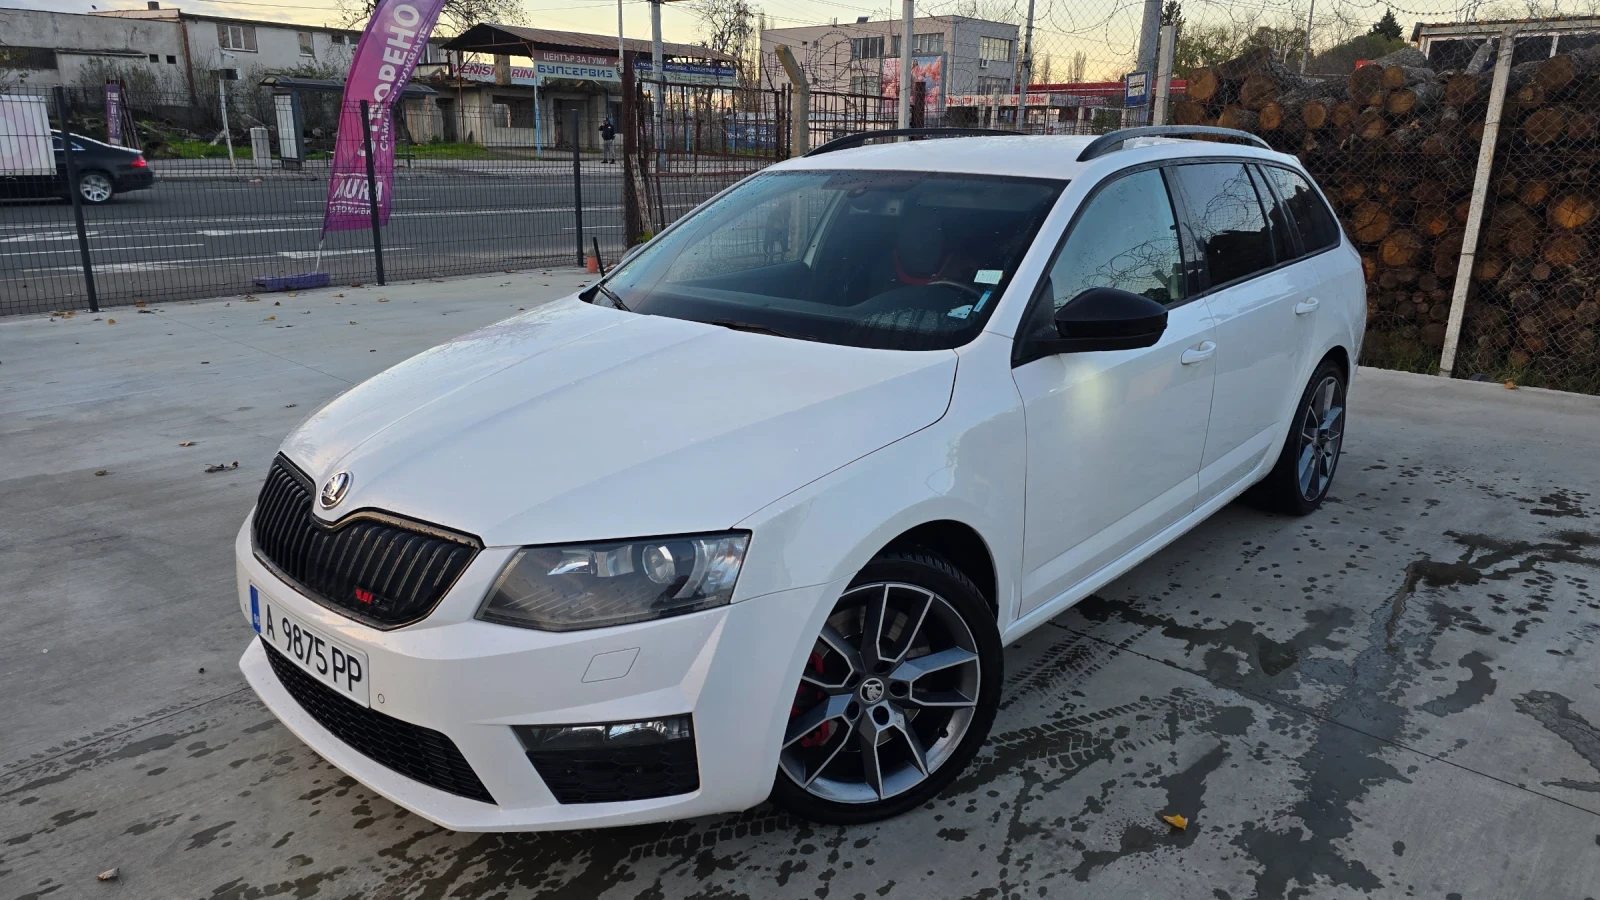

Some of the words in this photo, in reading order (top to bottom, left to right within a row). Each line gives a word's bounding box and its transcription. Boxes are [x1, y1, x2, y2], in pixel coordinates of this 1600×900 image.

[543, 52, 575, 62] ЦЕНТЪР
[576, 55, 587, 64] ЗА
[588, 56, 607, 65] ГУМИ
[266, 604, 276, 641] A
[282, 617, 328, 676] 9875
[331, 646, 363, 692] PP
